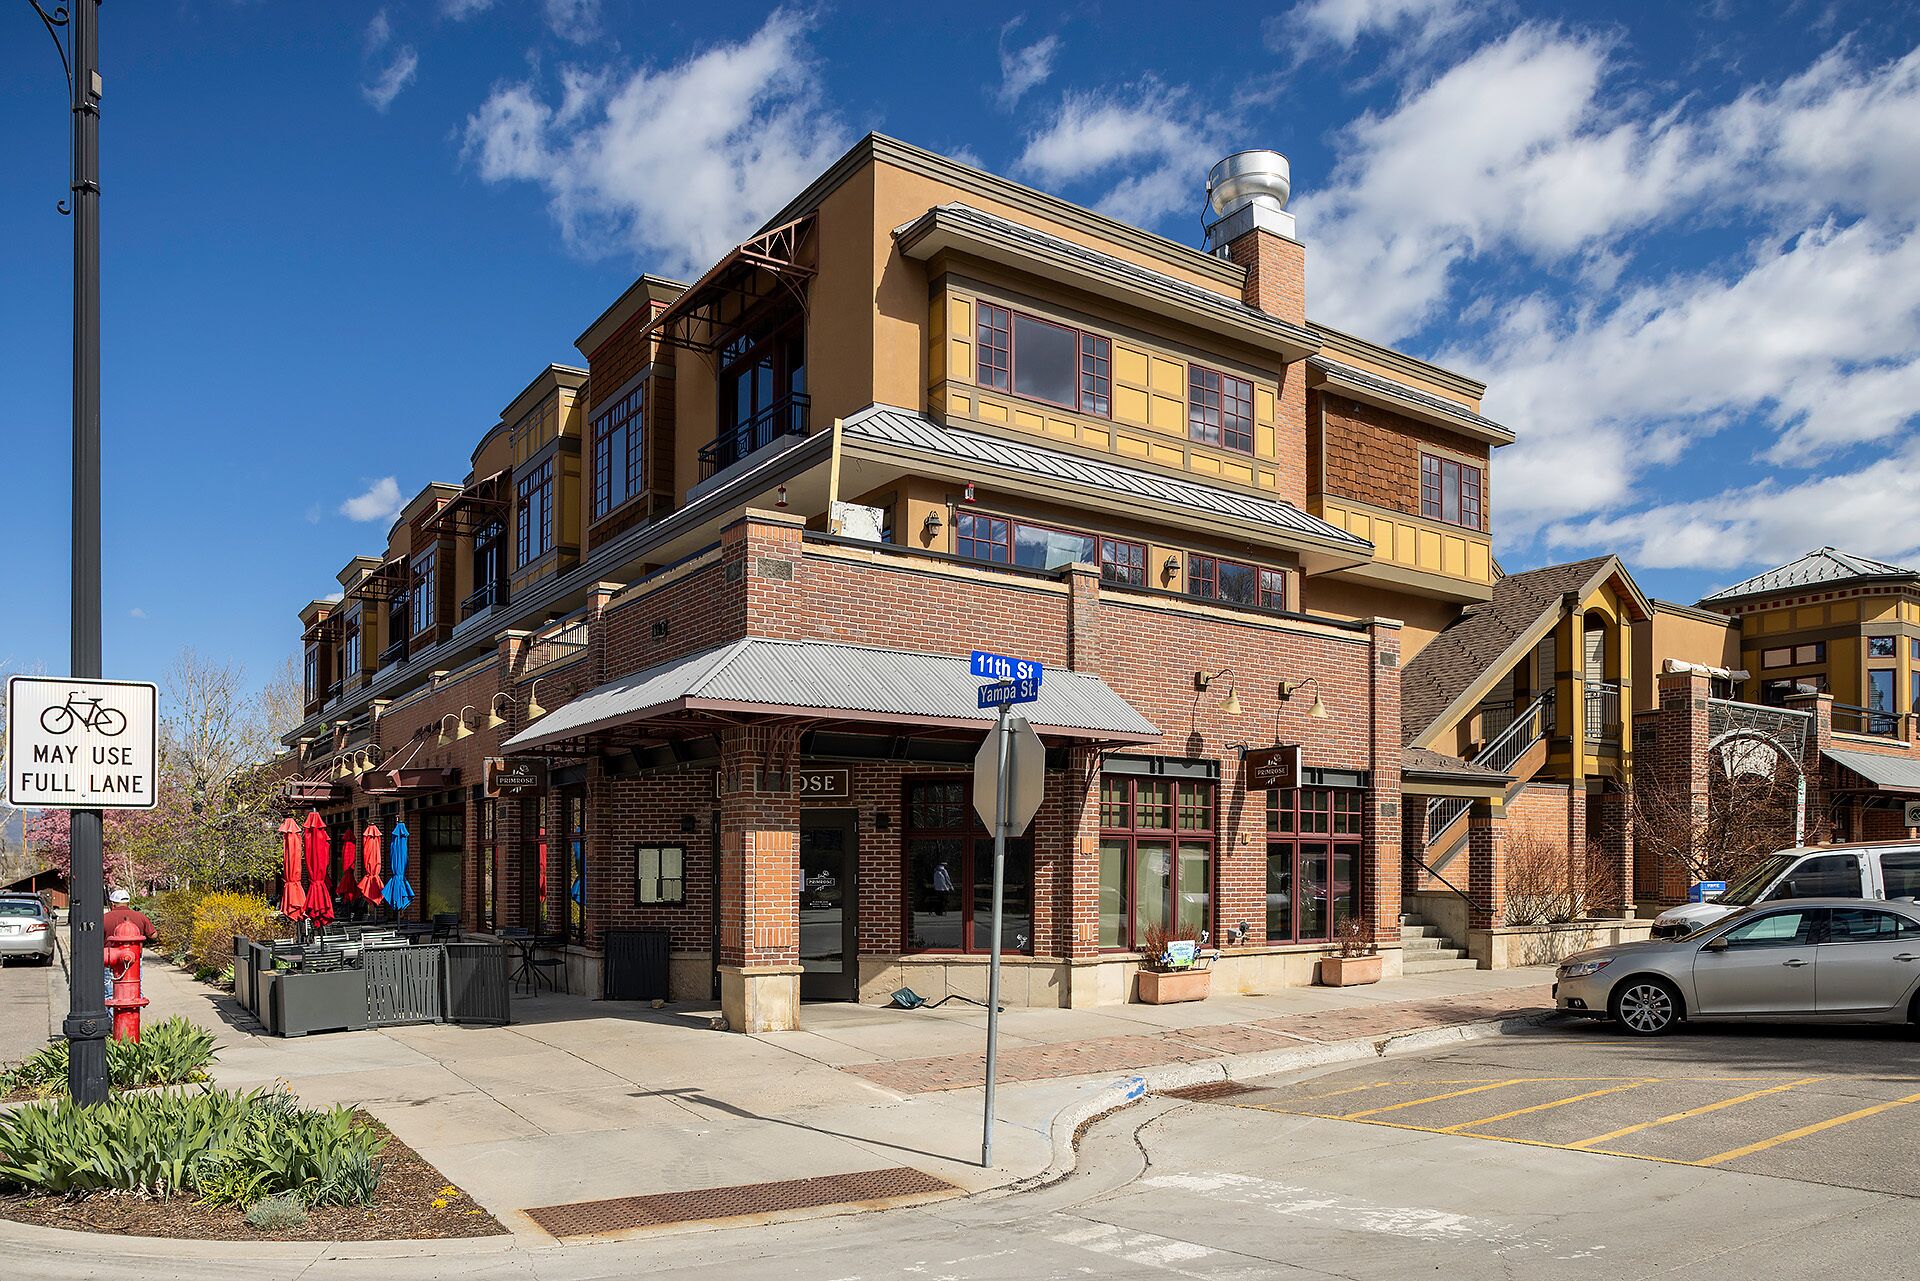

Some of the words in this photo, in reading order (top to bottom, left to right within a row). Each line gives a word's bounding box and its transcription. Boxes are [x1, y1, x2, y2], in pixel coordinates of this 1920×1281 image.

[978, 655, 1011, 676] 11th
[1016, 662, 1034, 679] St
[981, 686, 1017, 703] Yampa
[1020, 680, 1036, 698] St.
[34, 744, 78, 763] MAY
[92, 747, 133, 765] USE
[1257, 767, 1286, 776] PRIMROSE
[22, 773, 75, 791] FULL
[90, 774, 143, 793] LANE
